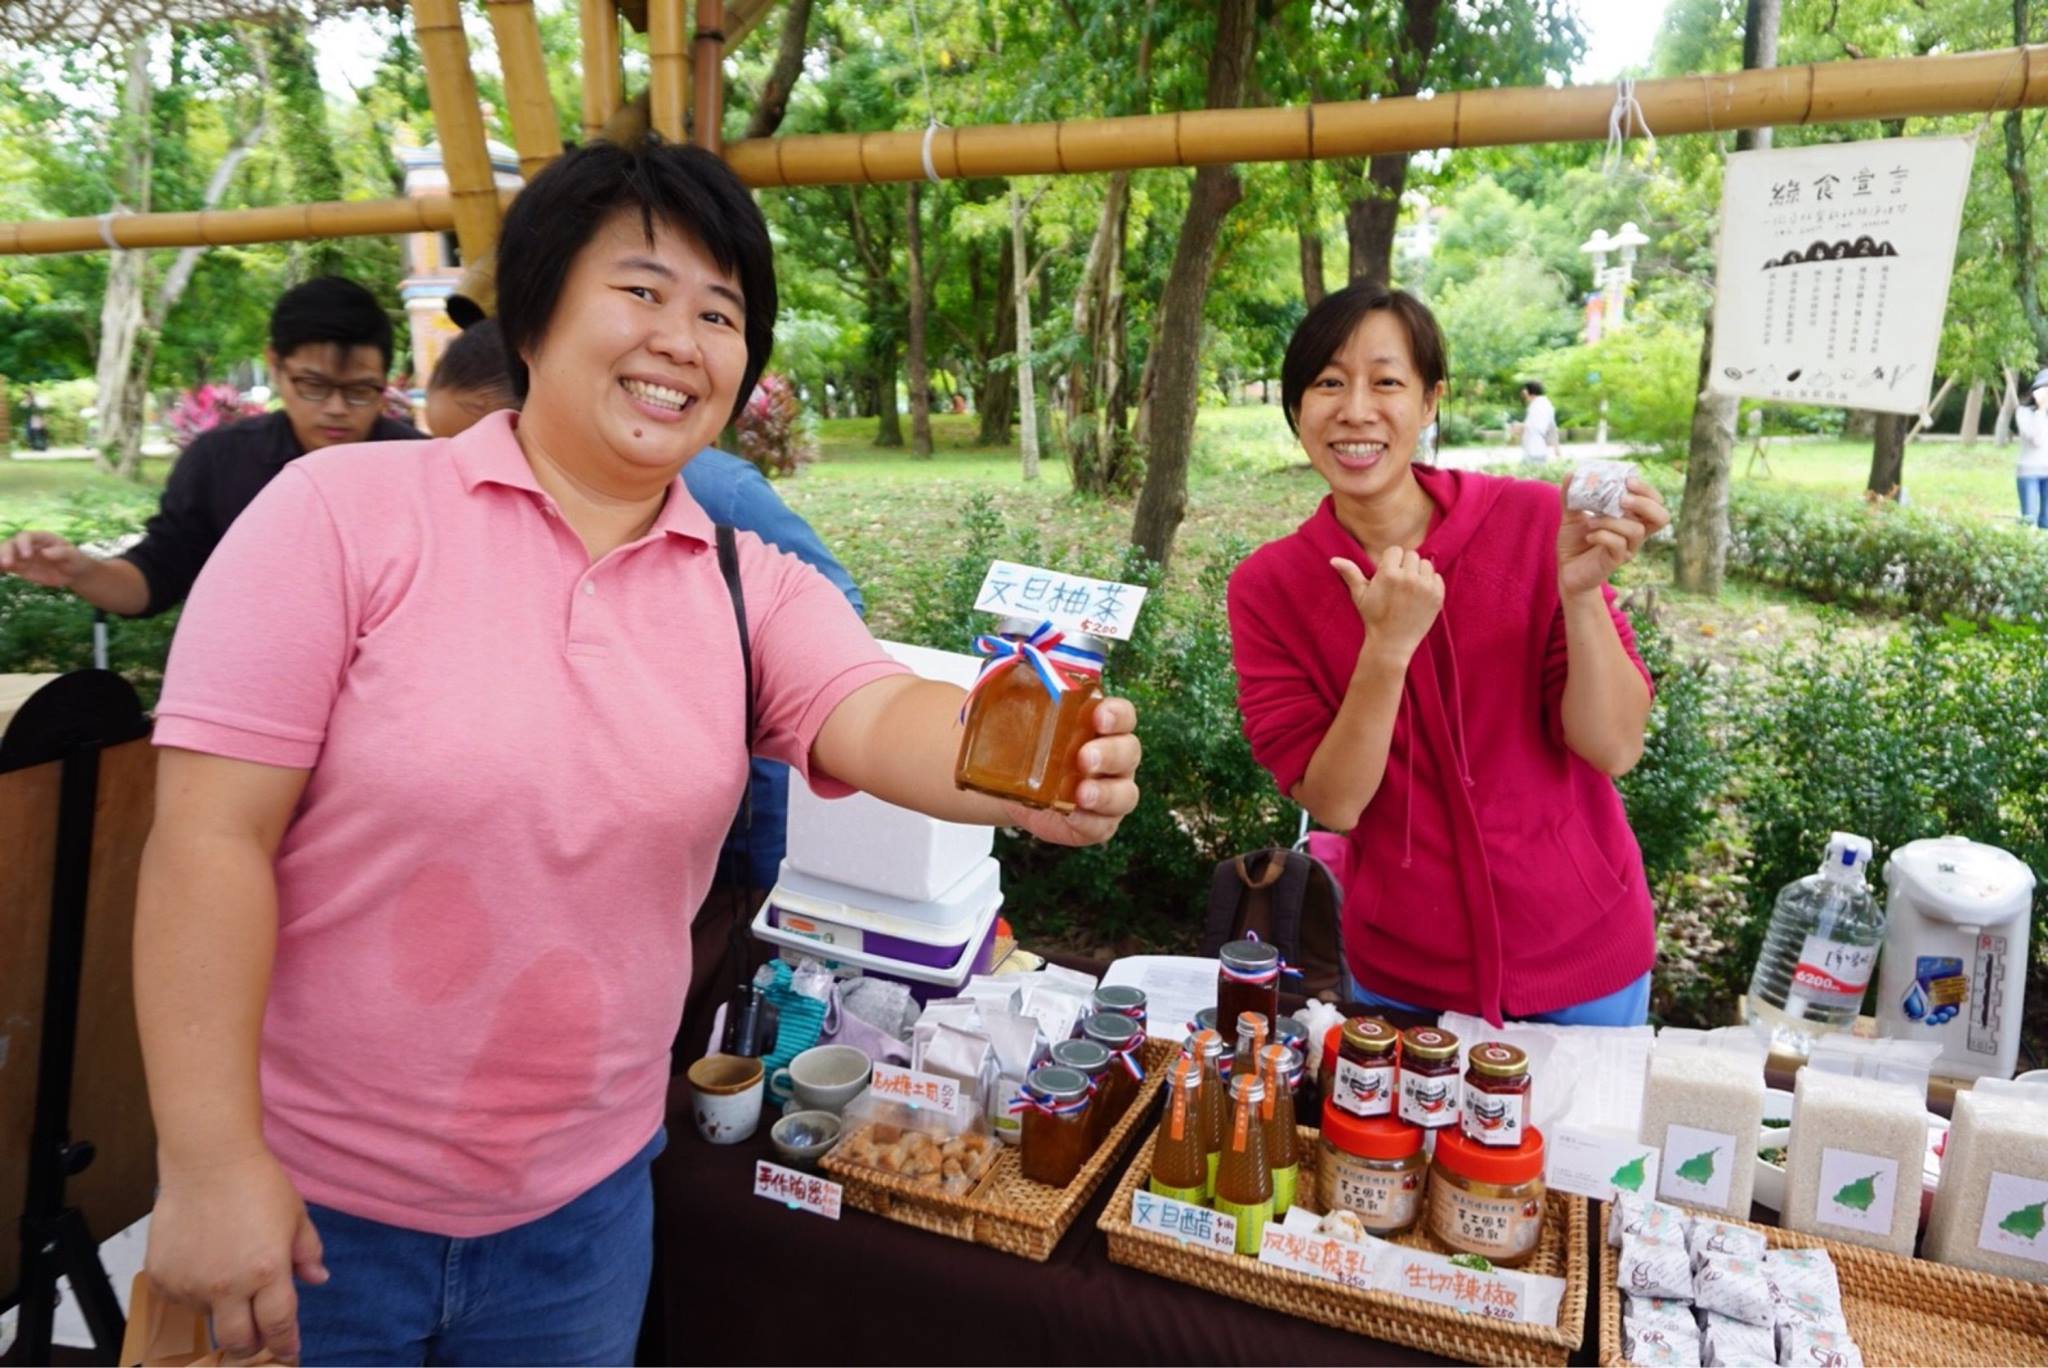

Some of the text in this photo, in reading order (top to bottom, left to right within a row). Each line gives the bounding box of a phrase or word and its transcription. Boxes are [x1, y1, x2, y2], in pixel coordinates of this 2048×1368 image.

[982, 568, 1128, 622] 文旦柚茶
[1080, 618, 1118, 635] $200
[1795, 970, 1832, 988] 6200
[1137, 1195, 1213, 1240] 文旦醋
[1404, 1262, 1518, 1309] 生切辣椒
